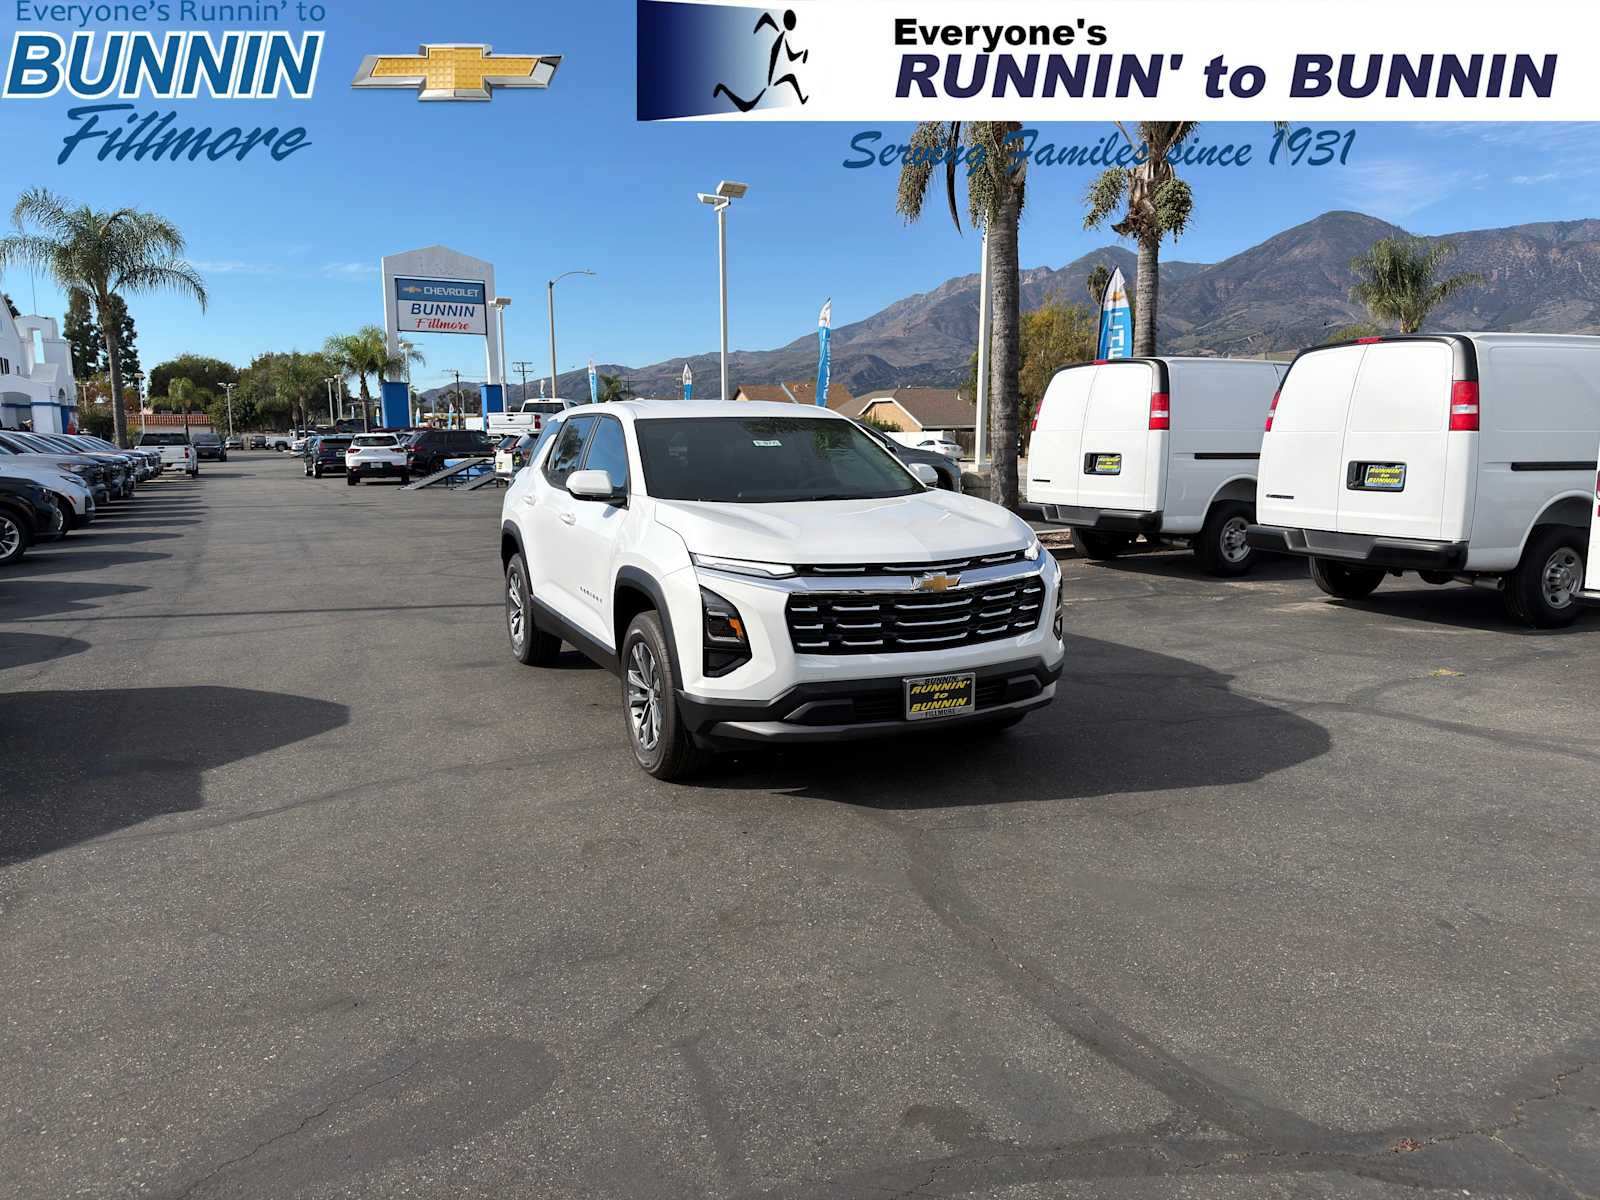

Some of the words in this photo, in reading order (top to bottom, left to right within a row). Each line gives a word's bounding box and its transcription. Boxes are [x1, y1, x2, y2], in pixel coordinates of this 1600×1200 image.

[423, 286, 480, 297] CHEVROLET
[411, 303, 475, 318] BUNNIN
[415, 318, 470, 330] Fillmore
[911, 681, 971, 694] RUNNIN'
[911, 698, 968, 713] BUNNIN
